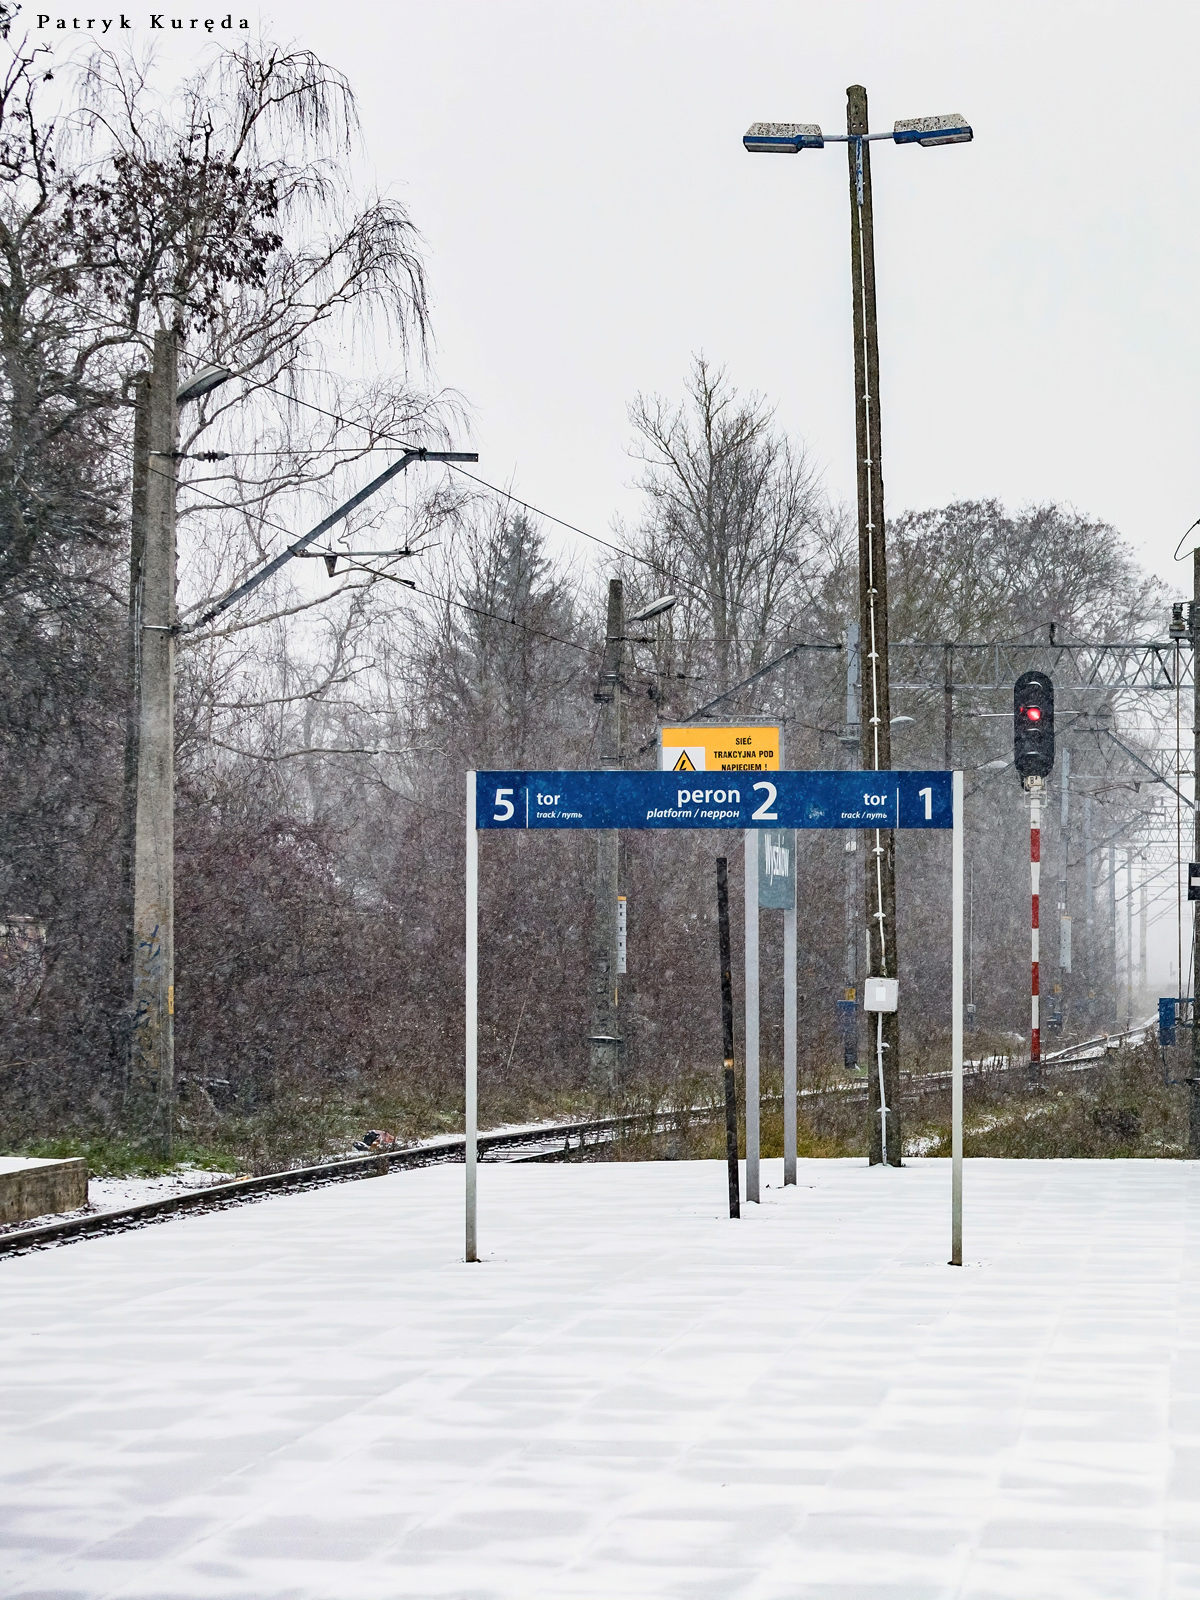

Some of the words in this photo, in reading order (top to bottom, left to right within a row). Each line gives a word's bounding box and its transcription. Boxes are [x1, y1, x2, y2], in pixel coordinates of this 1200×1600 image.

[735, 735, 752, 745] SIEĆ
[713, 750, 756, 759] TRAKCYJNA
[758, 750, 774, 758] POD
[493, 788, 515, 822] 5
[536, 792, 561, 806] tor
[677, 789, 740, 808] peron
[751, 781, 778, 820] 2
[863, 793, 888, 806] tor
[918, 787, 932, 820] 1
[536, 811, 556, 819] track
[646, 808, 692, 820] platform
[841, 811, 861, 819] track
